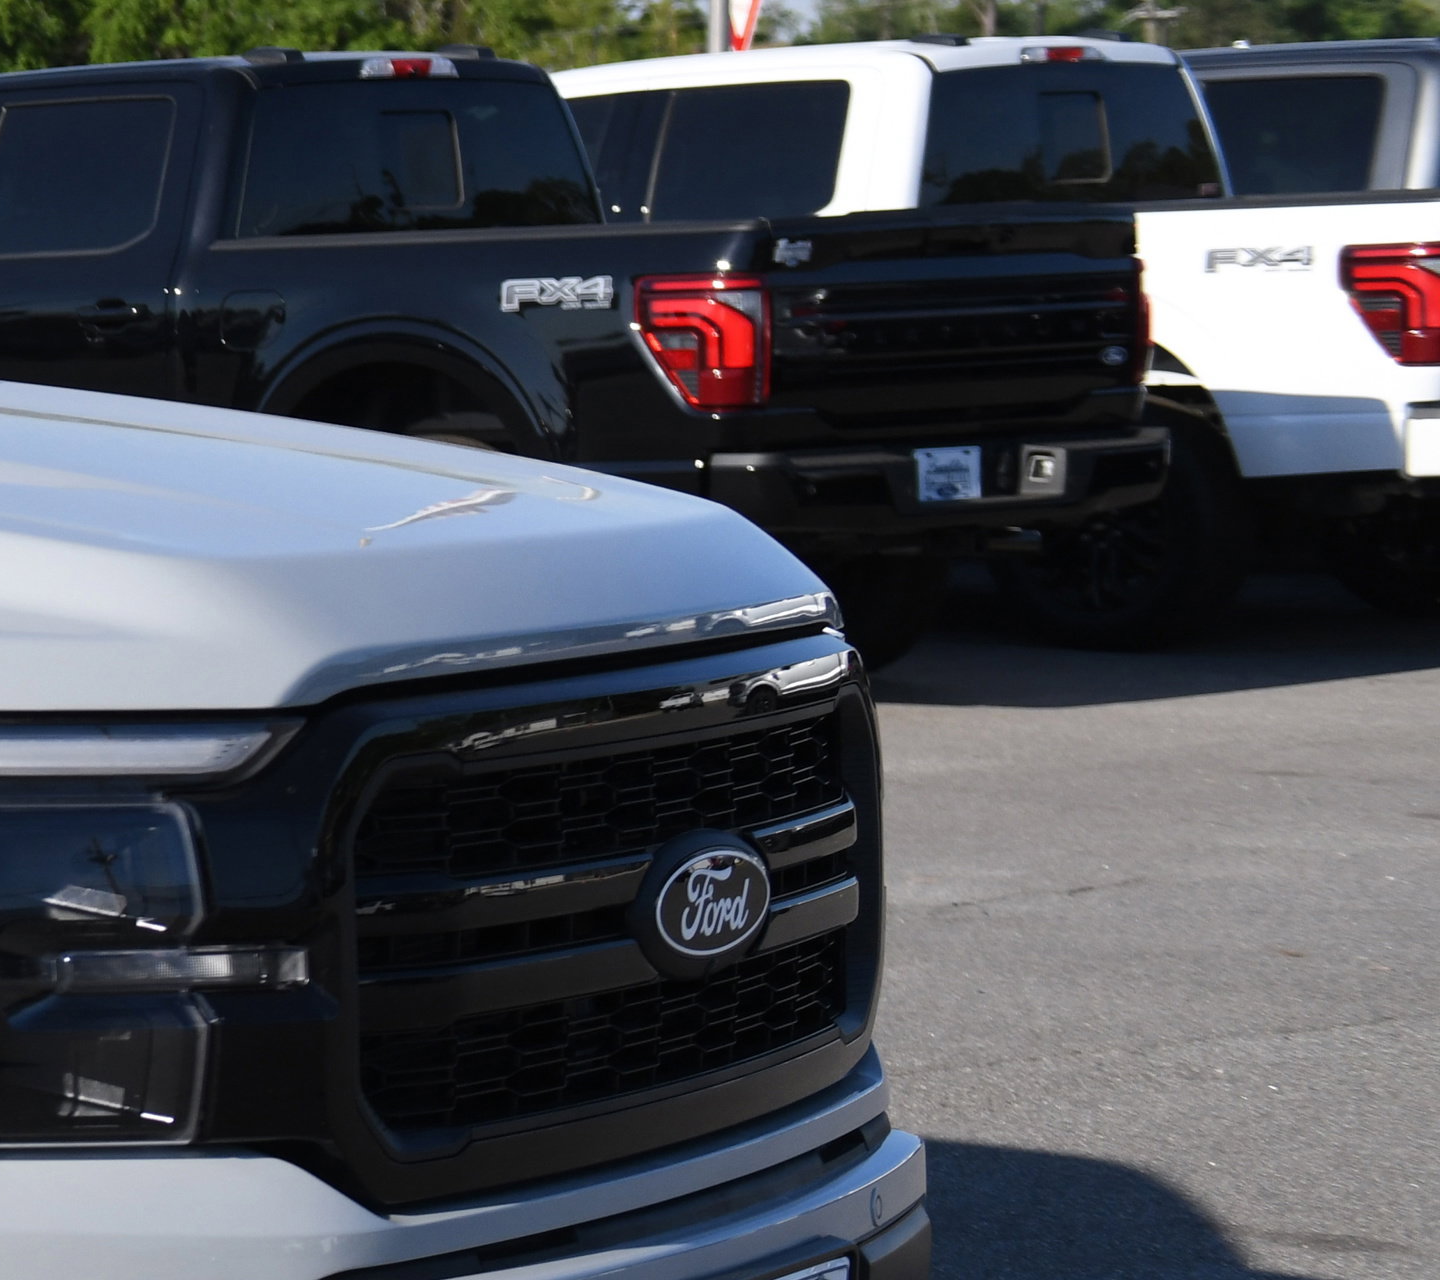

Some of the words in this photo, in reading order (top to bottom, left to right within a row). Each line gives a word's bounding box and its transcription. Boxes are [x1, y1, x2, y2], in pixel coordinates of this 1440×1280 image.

[1205, 246, 1314, 273] FX4
[500, 275, 613, 312] FX4
[681, 866, 750, 941] Ford
